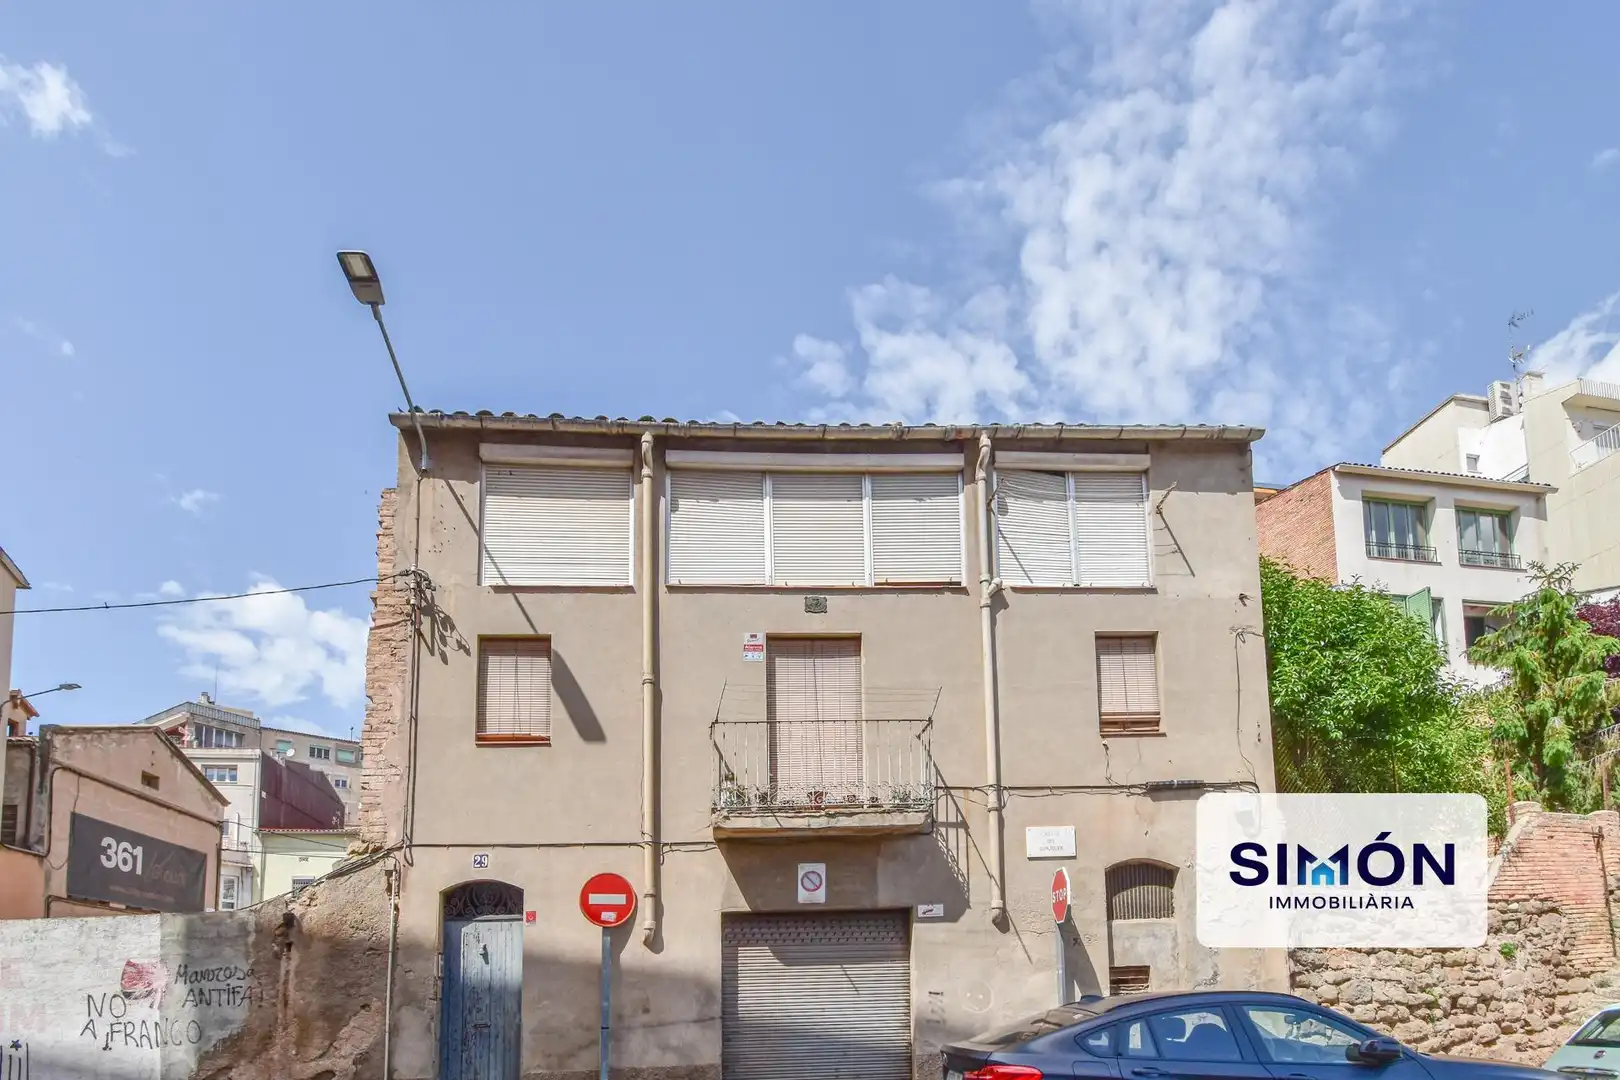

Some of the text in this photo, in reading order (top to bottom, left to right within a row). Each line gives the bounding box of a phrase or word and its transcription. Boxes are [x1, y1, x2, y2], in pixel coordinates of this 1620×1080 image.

[100, 836, 144, 876] 361
[474, 855, 488, 868] 29
[1052, 887, 1067, 904] STOP
[87, 992, 128, 1019] NO
[80, 1017, 202, 1050] A FRANCO
